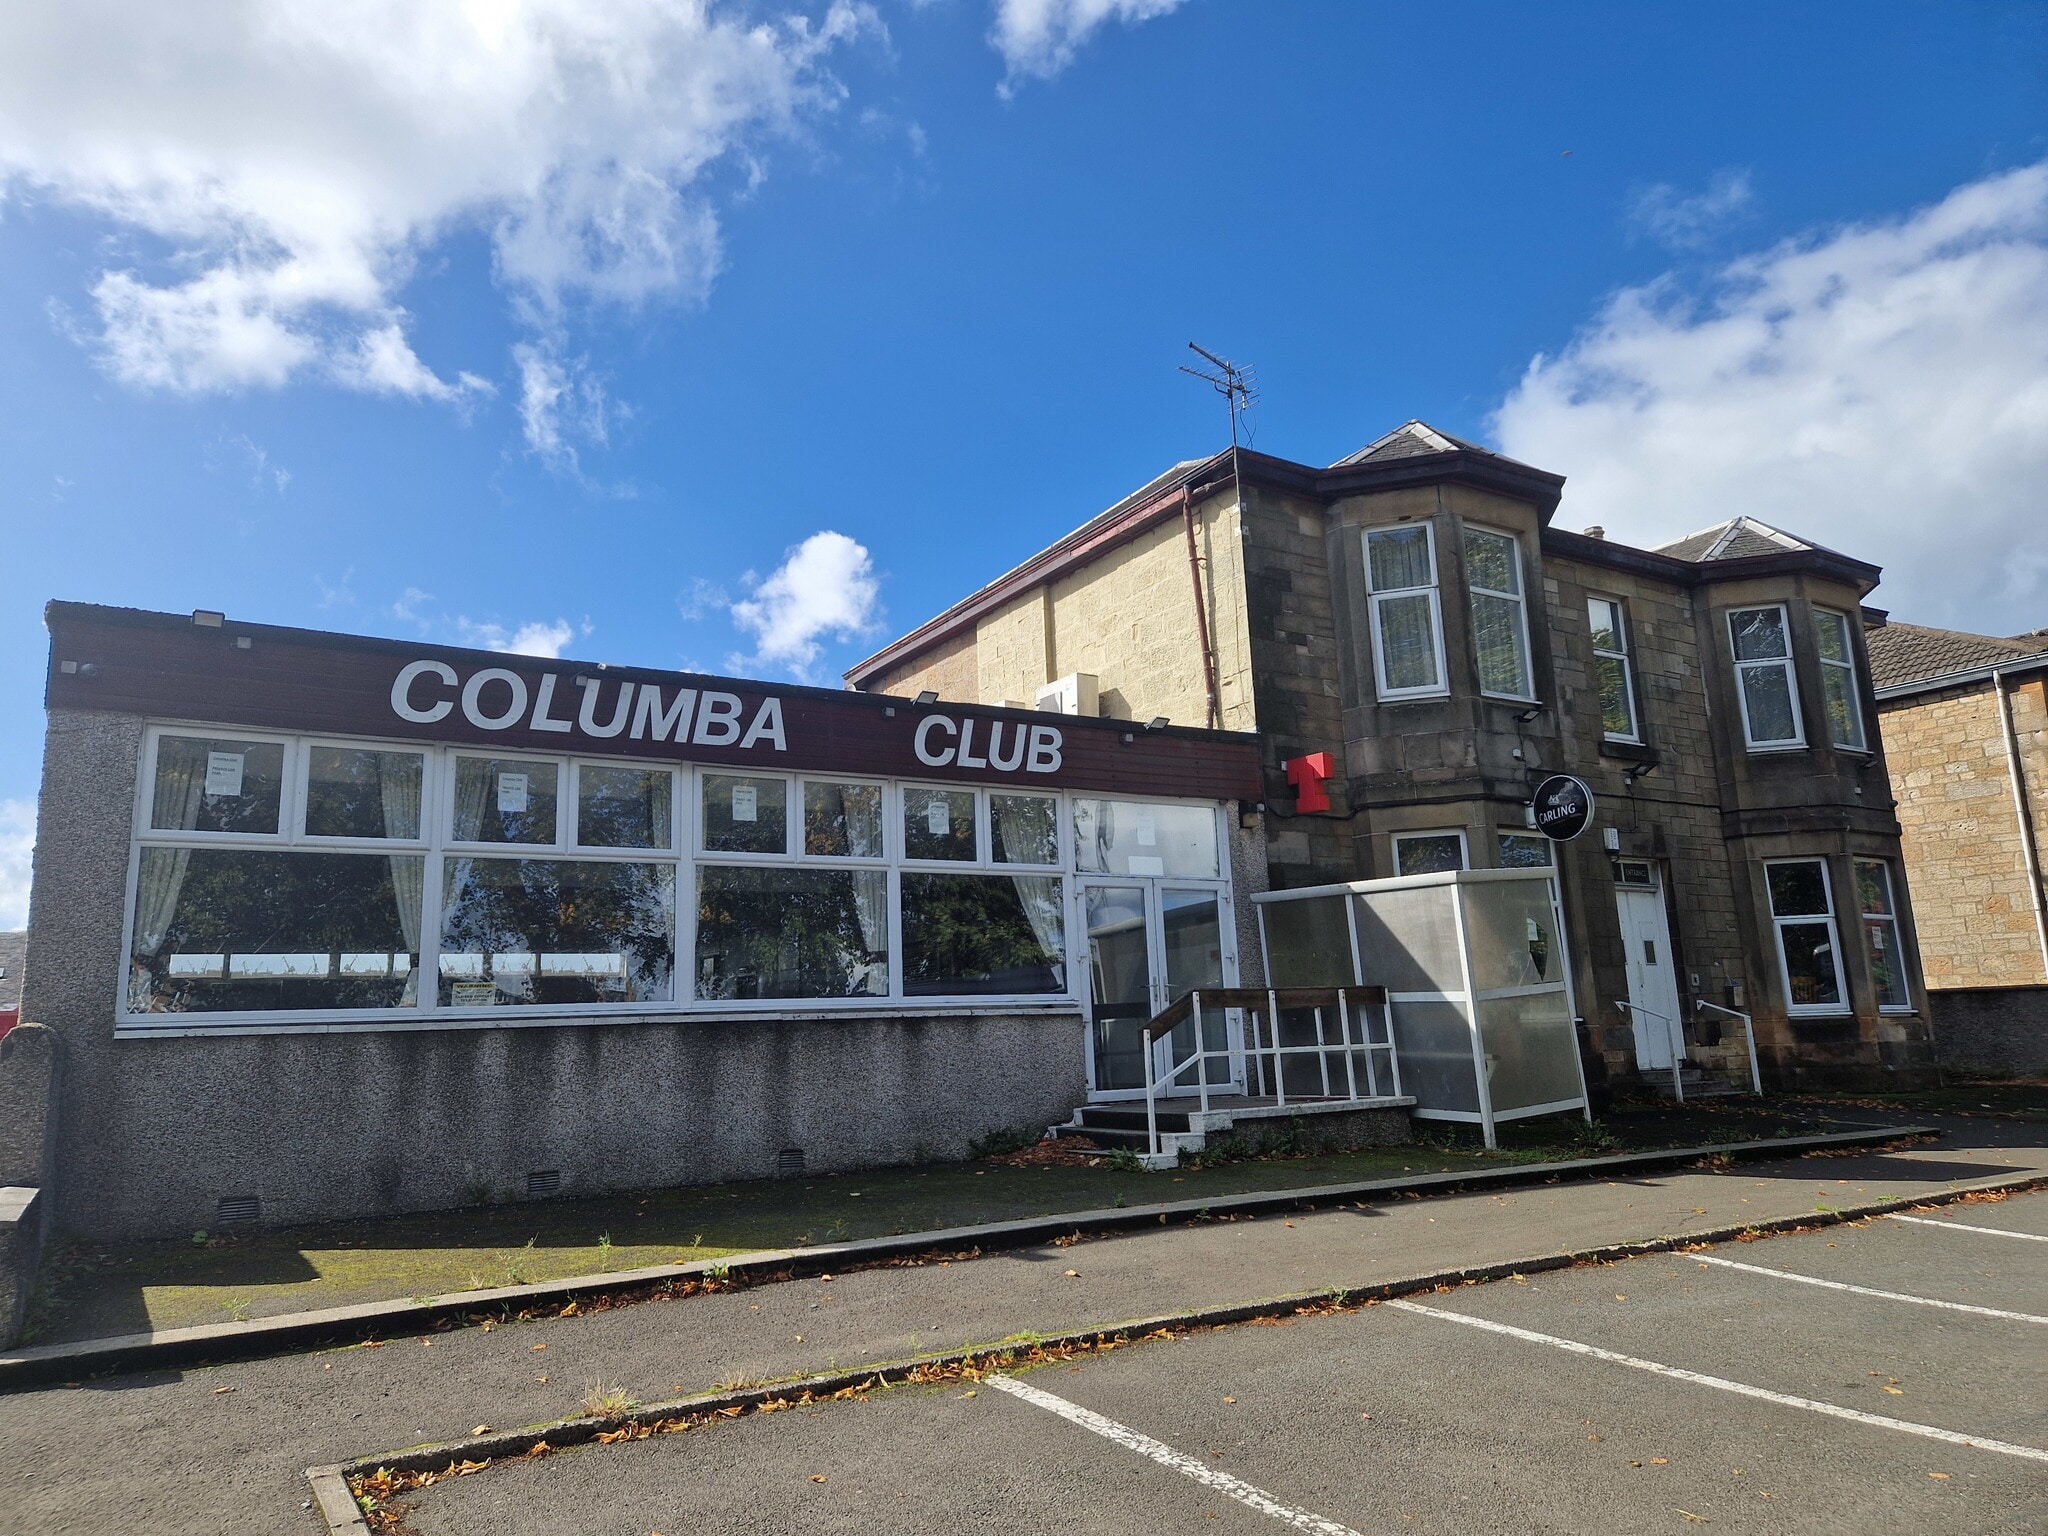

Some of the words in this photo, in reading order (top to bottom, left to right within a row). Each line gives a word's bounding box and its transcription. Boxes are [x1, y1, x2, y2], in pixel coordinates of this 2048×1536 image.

[390, 659, 787, 751] COLUMBA
[914, 714, 1063, 773] CLUB
[1538, 803, 1576, 824] CARLING
